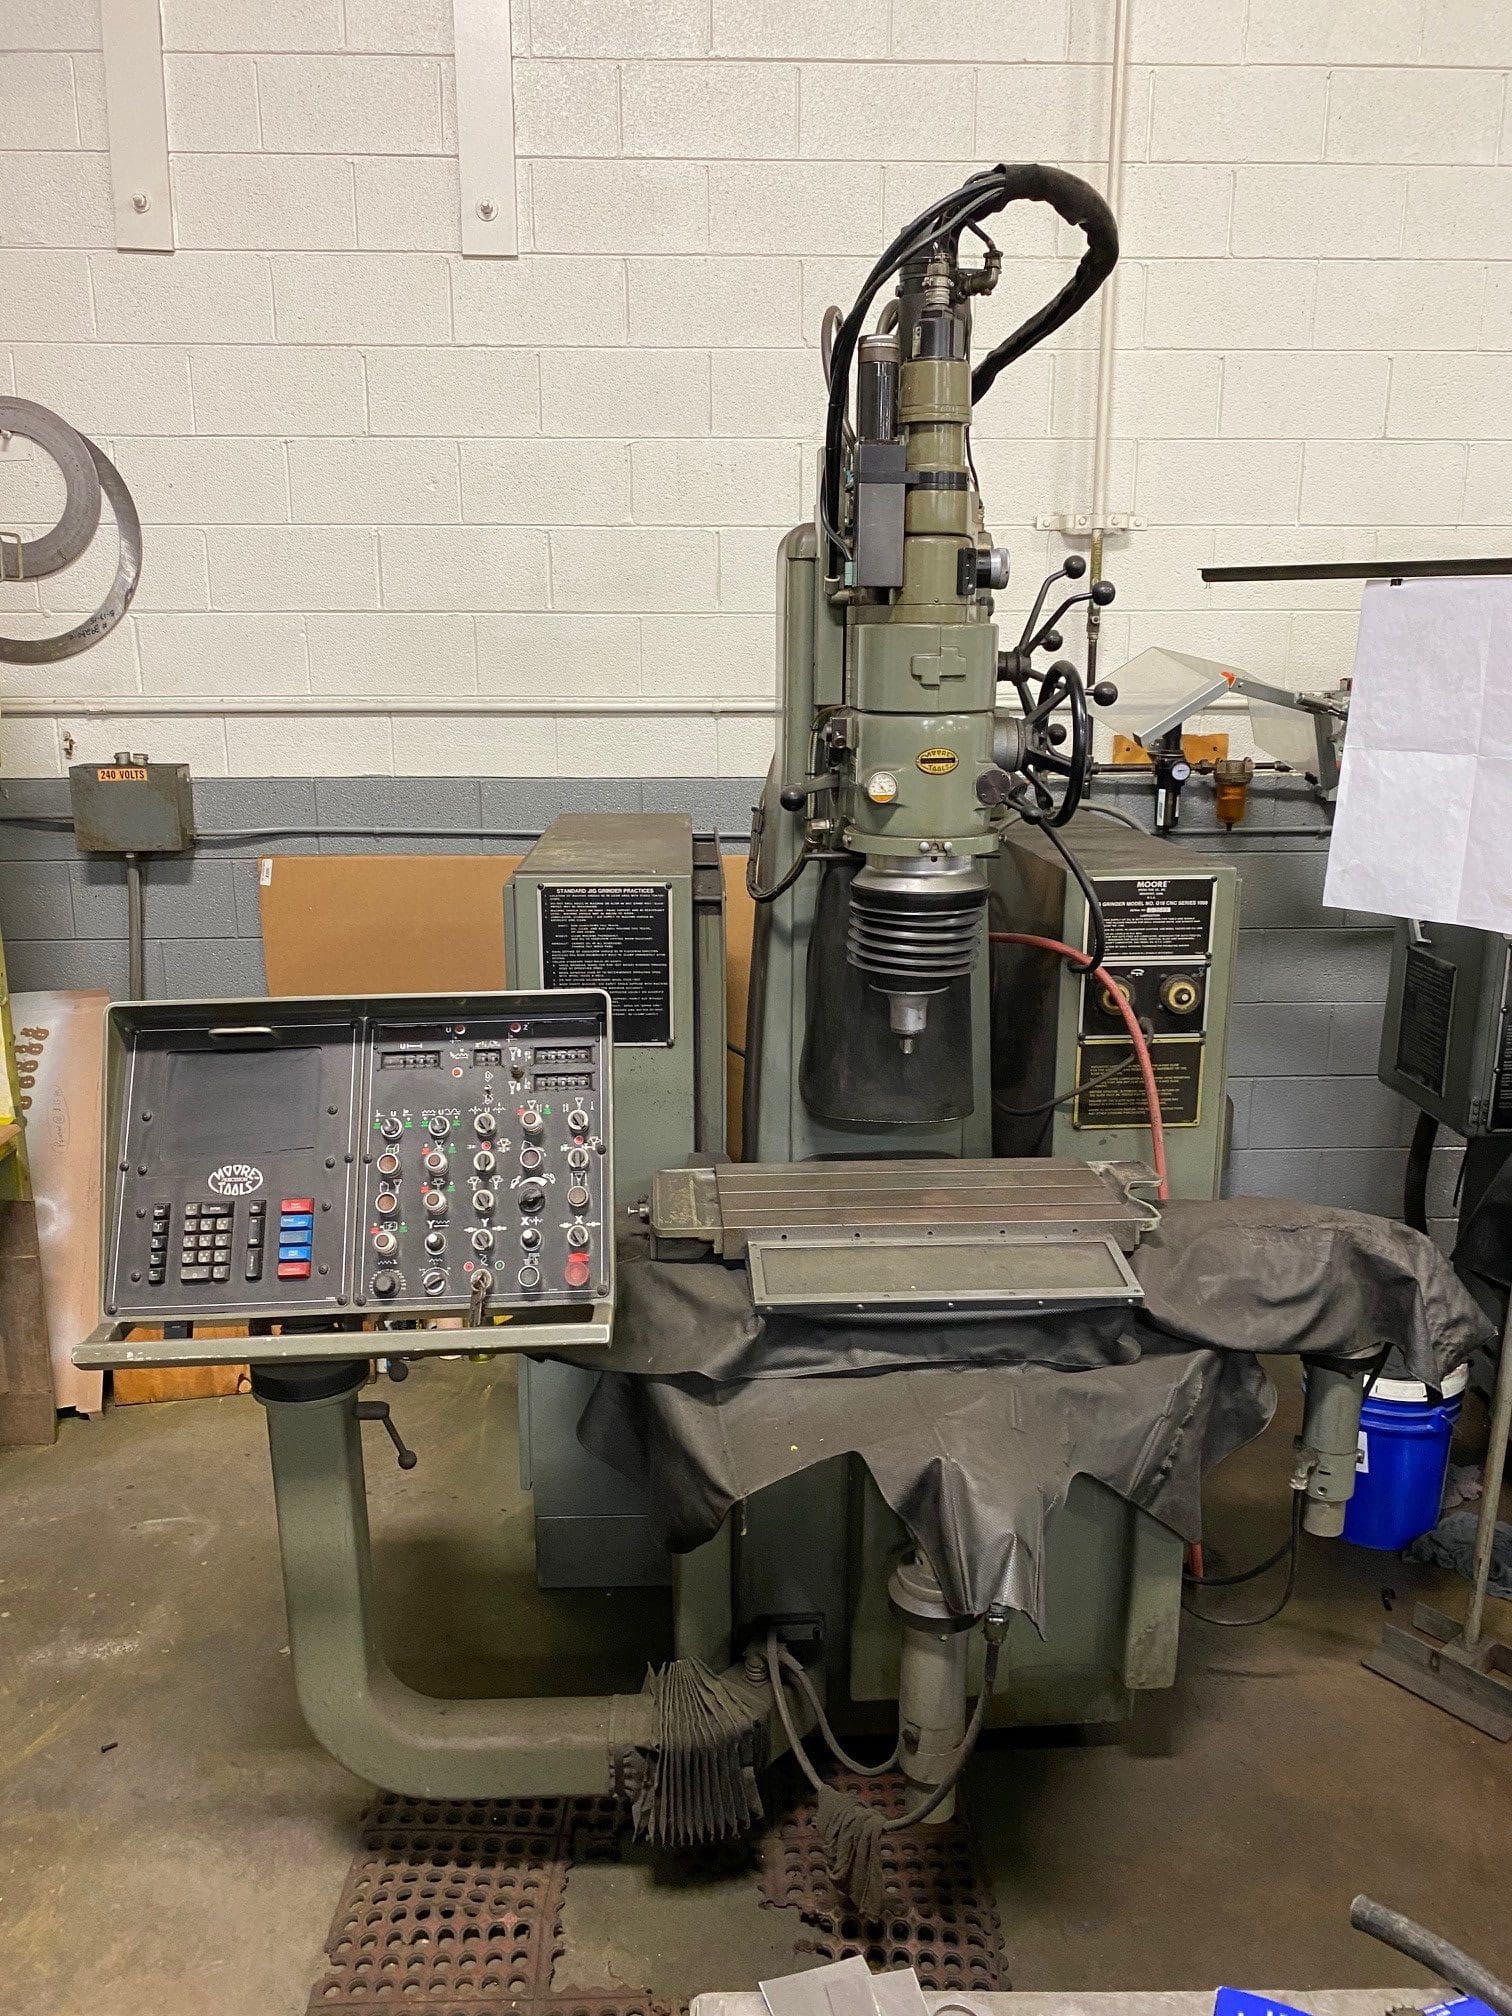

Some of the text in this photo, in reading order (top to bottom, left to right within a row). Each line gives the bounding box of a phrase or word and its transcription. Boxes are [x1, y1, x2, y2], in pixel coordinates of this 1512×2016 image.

[100, 769, 145, 779] 240 VOLTS
[1136, 880, 1168, 888] MOORE
[213, 1165, 257, 1180] MOORE
[218, 1181, 253, 1195] TOOLS
[481, 1218, 490, 1227] Y
[520, 1216, 529, 1225] X
[574, 1215, 583, 1224] X
[427, 1220, 435, 1229] Y
